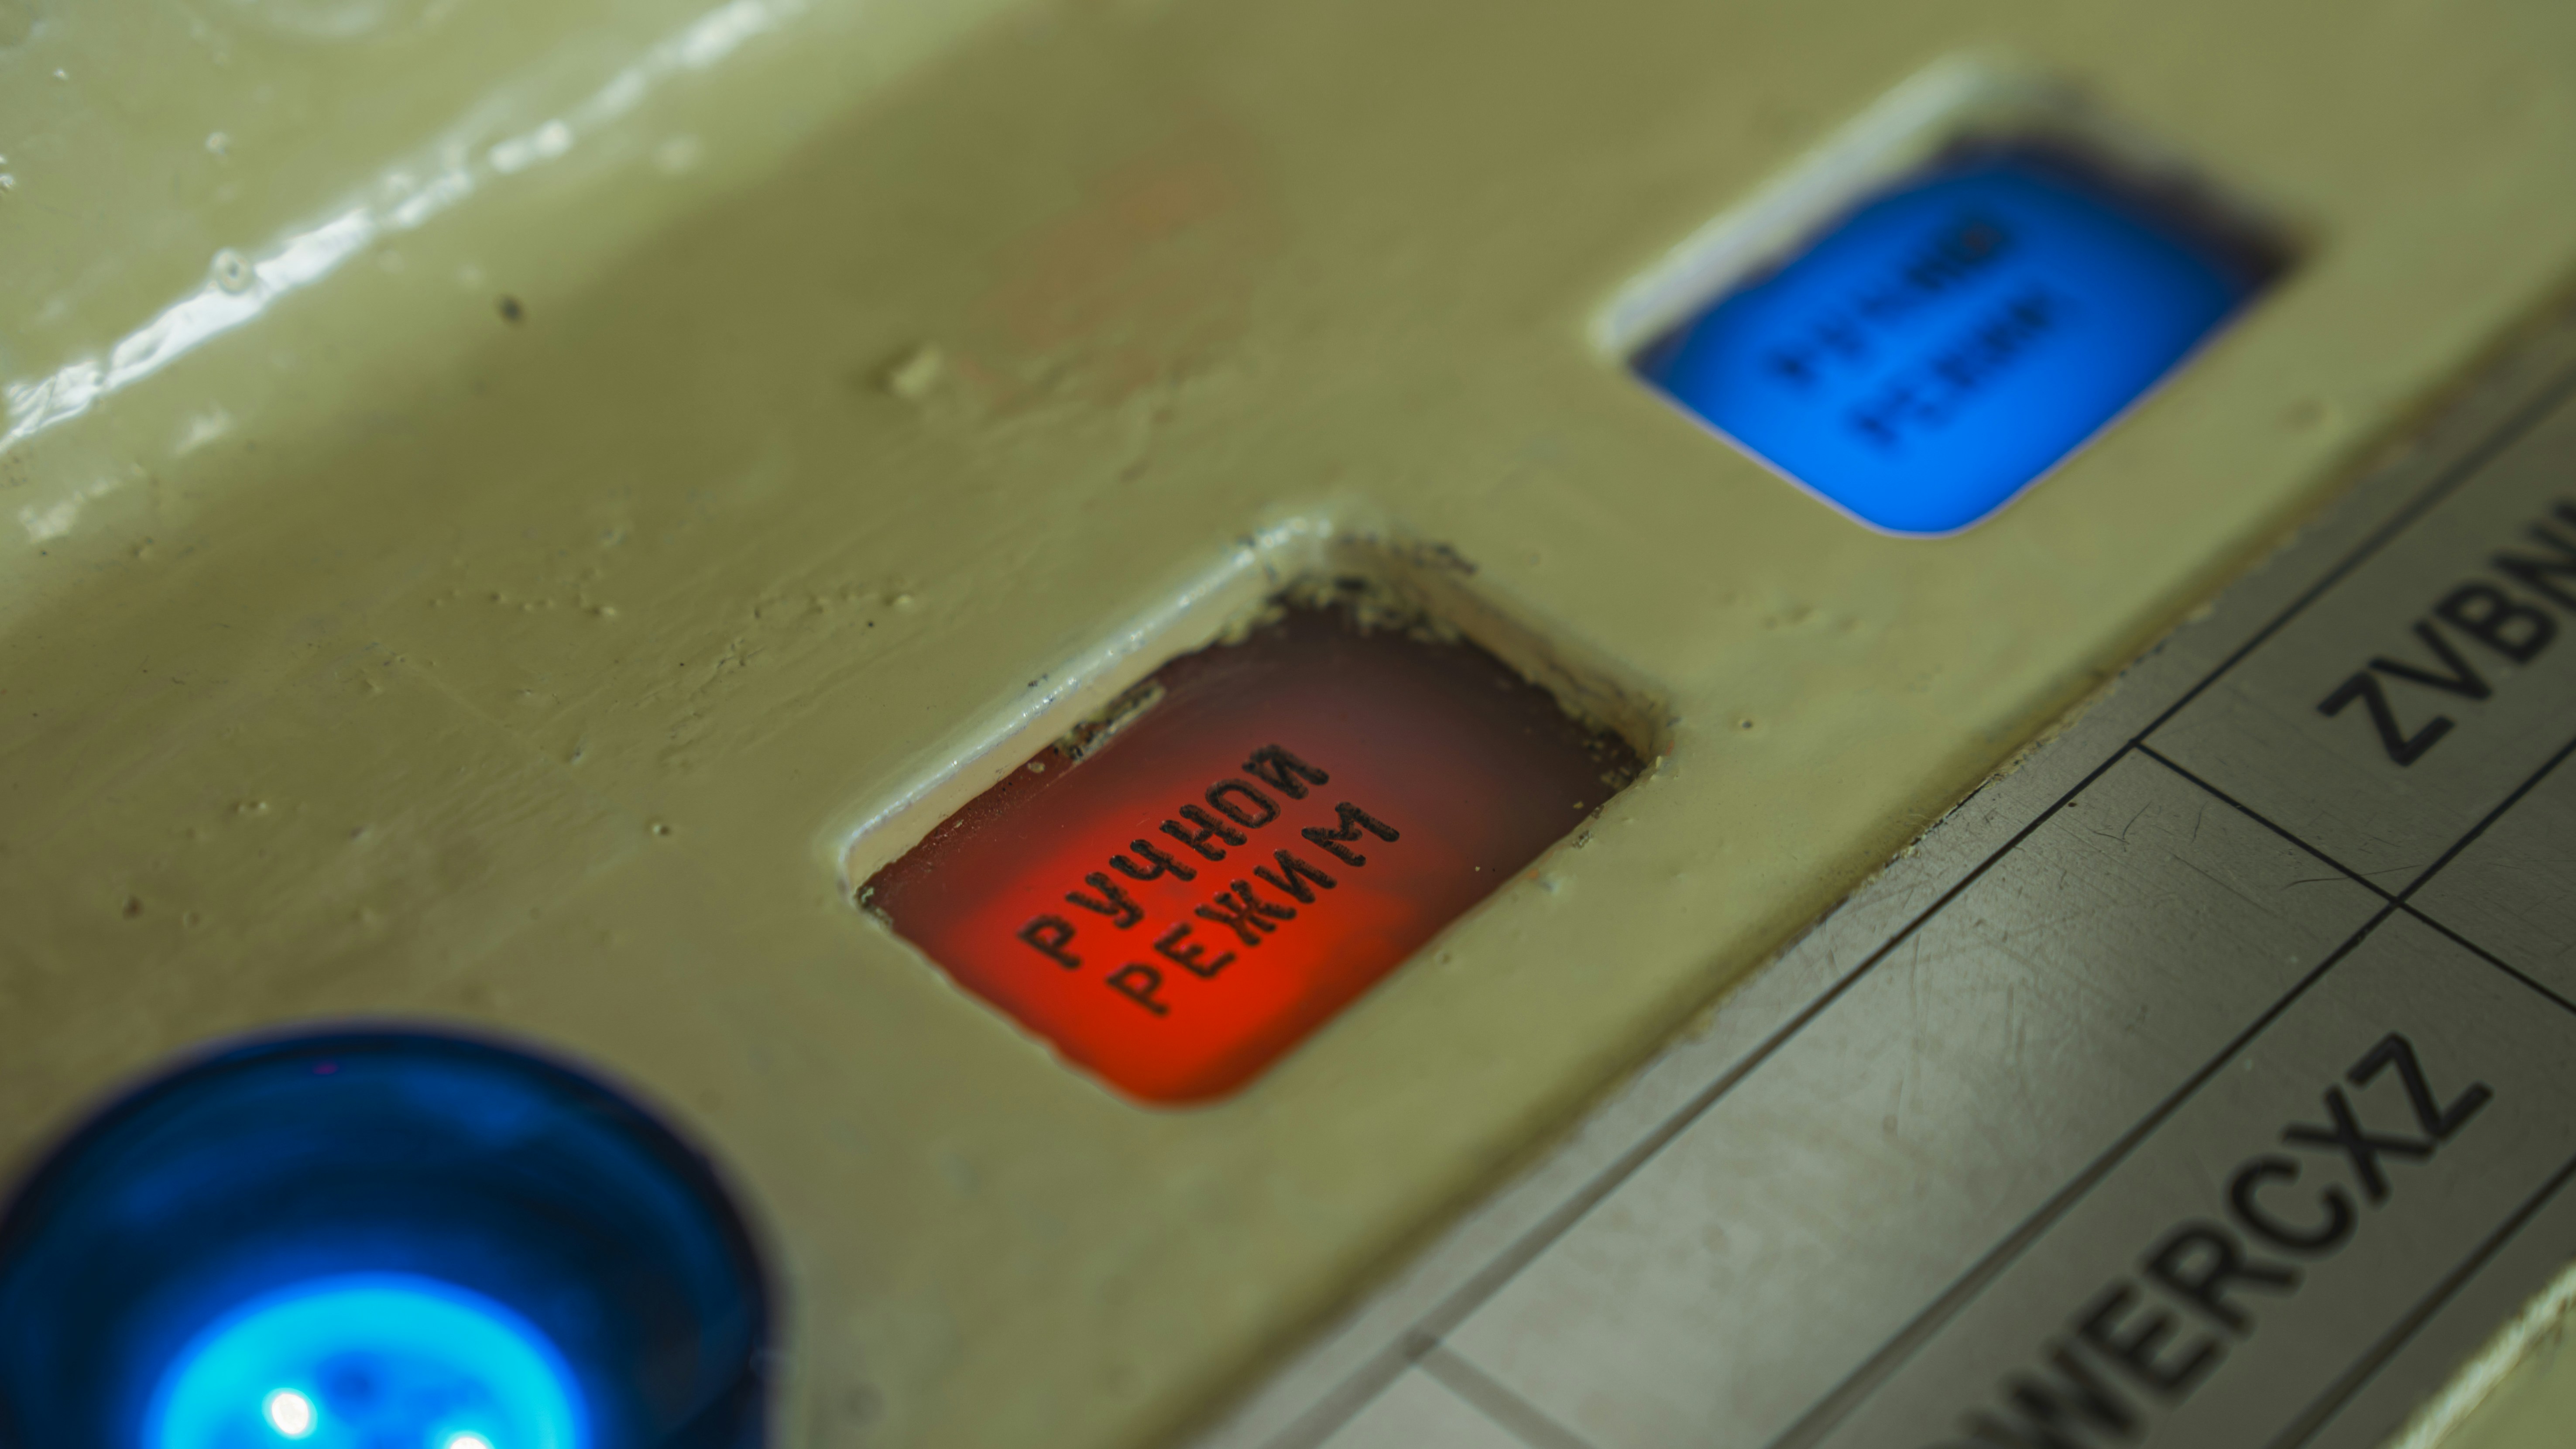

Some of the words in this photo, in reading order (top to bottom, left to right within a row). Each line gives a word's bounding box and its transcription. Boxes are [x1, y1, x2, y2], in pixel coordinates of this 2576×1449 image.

[2316, 498, 2576, 767] ZVBN
[1016, 743, 1329, 970] РУЧНОЙ
[1105, 801, 1399, 1016] РЕЖИМ
[1922, 1031, 2495, 1449] WERCXZ
